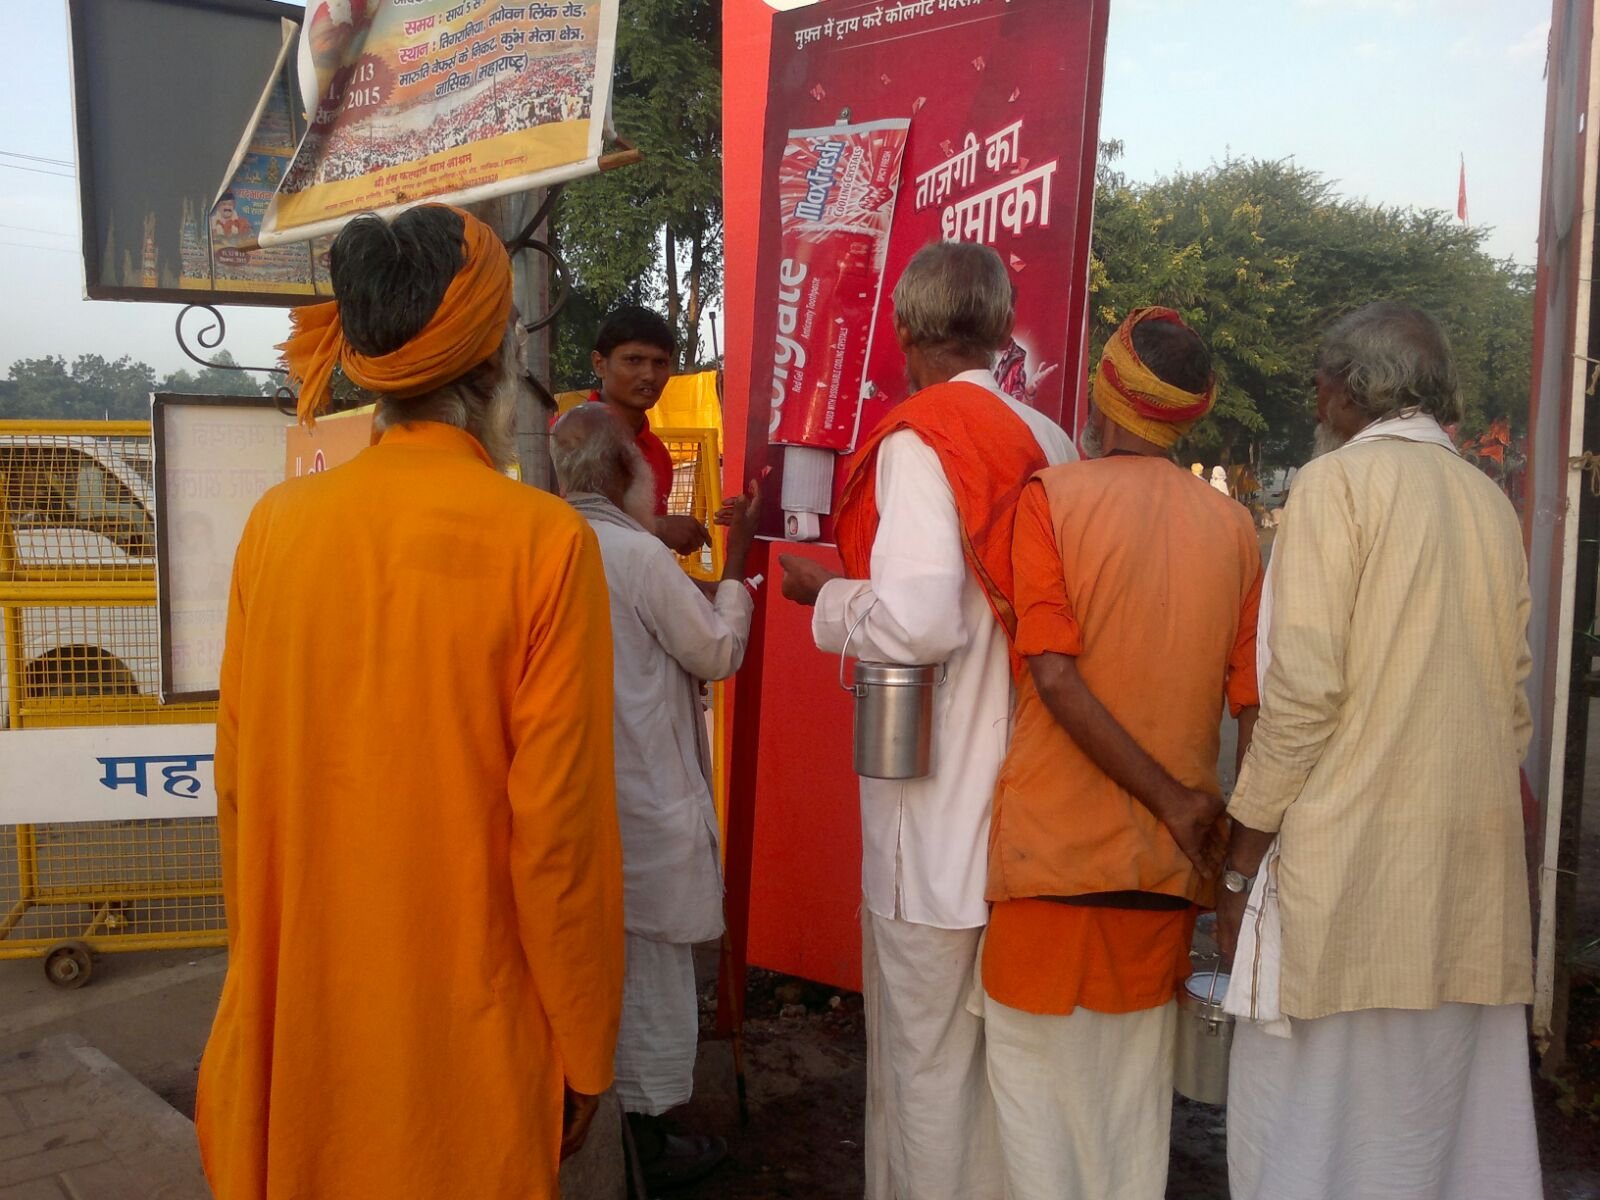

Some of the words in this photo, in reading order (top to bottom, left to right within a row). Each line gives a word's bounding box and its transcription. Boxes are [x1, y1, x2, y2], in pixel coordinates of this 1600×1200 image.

[399, 42, 430, 63] स्थान
[488, 5, 525, 28] तपोवन
[529, 3, 558, 20] लिंक
[404, 15, 436, 36] समय
[824, 18, 835, 38] में
[836, 17, 860, 41] ट्राय
[862, 6, 883, 29] करें
[885, 0, 935, 24] कोलगट
[399, 63, 431, 86] मारुति
[458, 48, 468, 64] के
[500, 28, 525, 51] कुंभ
[528, 26, 556, 43] मेला
[347, 86, 381, 110] 2015
[435, 73, 470, 97] नासिक
[794, 140, 847, 221] MaxFresh
[915, 131, 980, 210] ताज़गी
[985, 119, 1023, 172] का
[941, 160, 1057, 244] धमाका
[96, 753, 215, 799] मह
